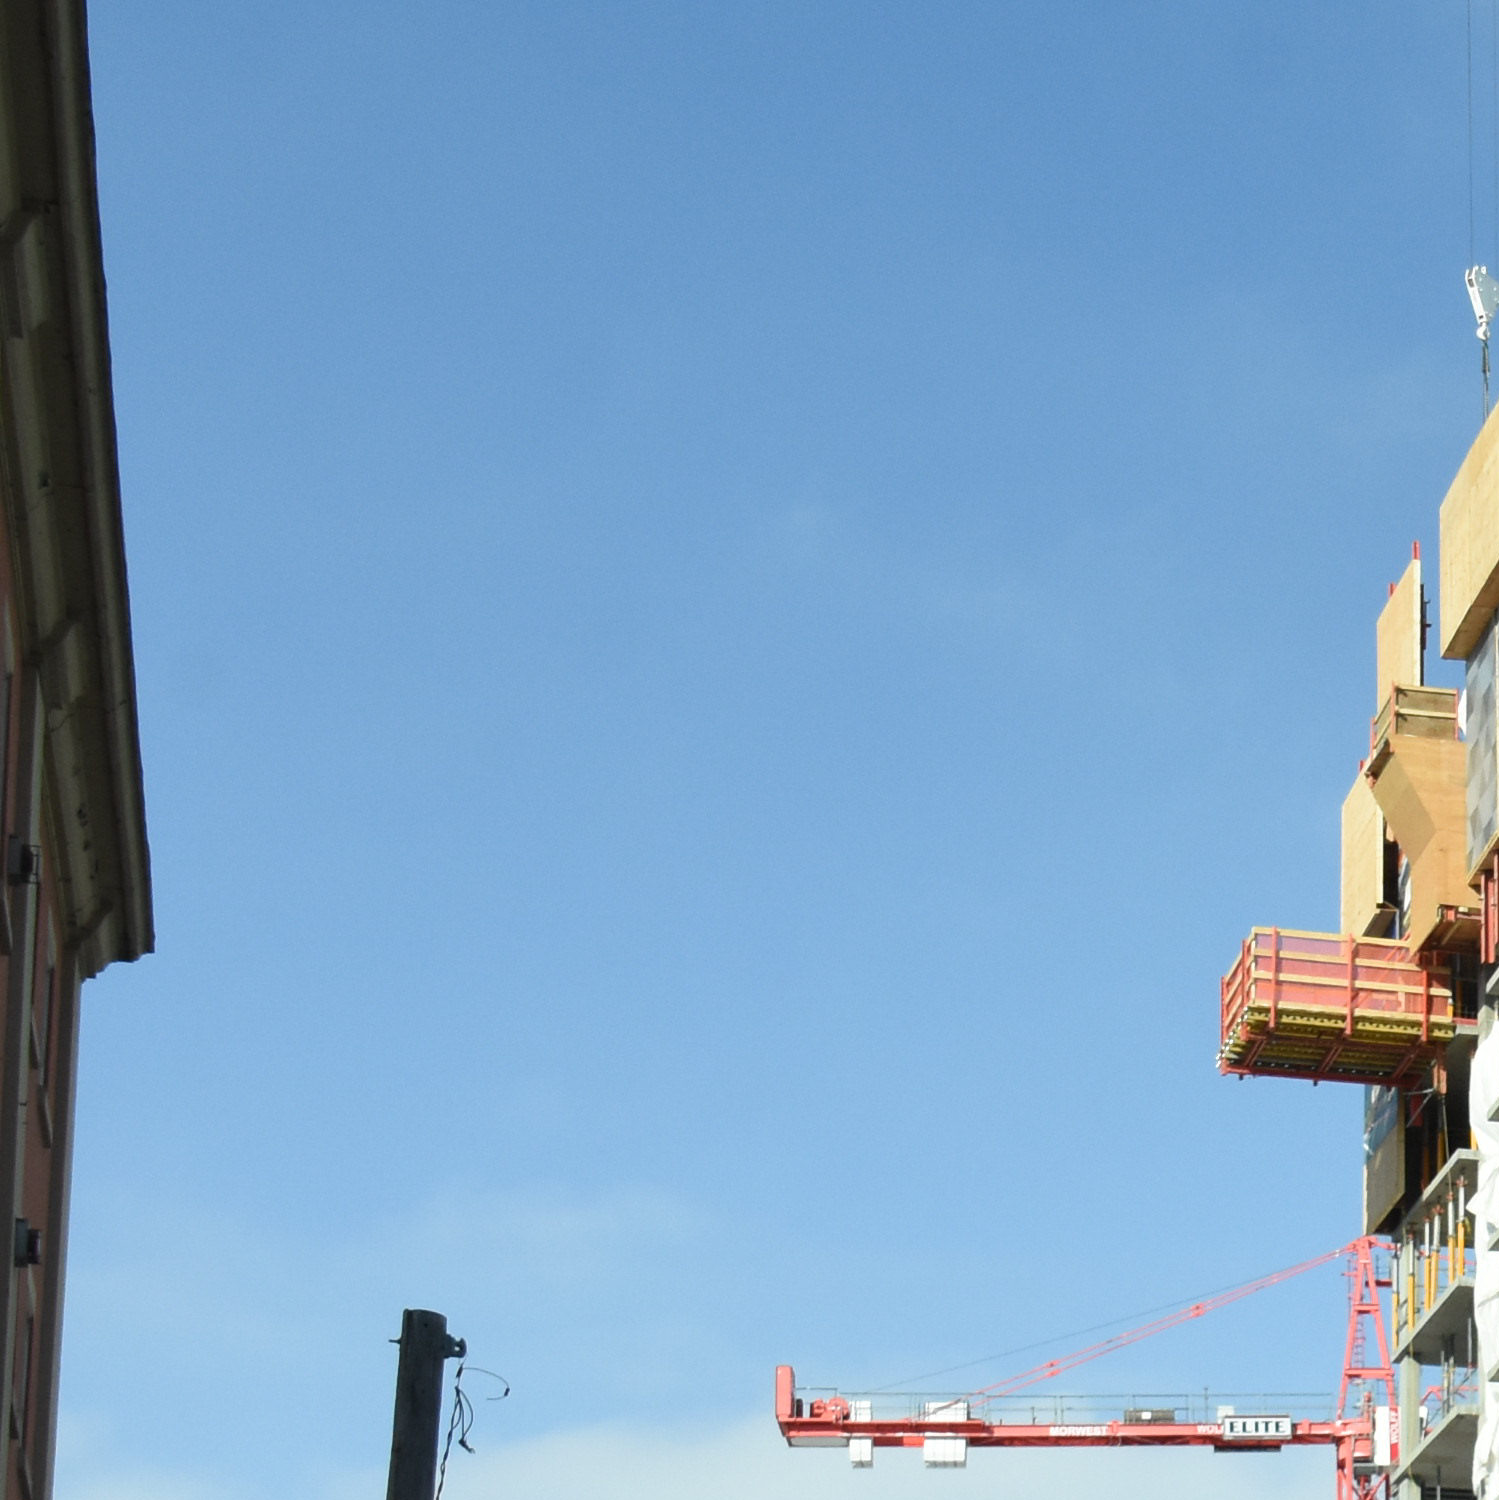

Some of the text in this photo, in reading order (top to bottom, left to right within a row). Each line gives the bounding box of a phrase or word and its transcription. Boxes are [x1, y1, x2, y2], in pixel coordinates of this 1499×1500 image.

[1049, 1425, 1108, 1436] MORWEST
[1196, 1425, 1224, 1434] WOL
[1229, 1420, 1287, 1434] ELITE
